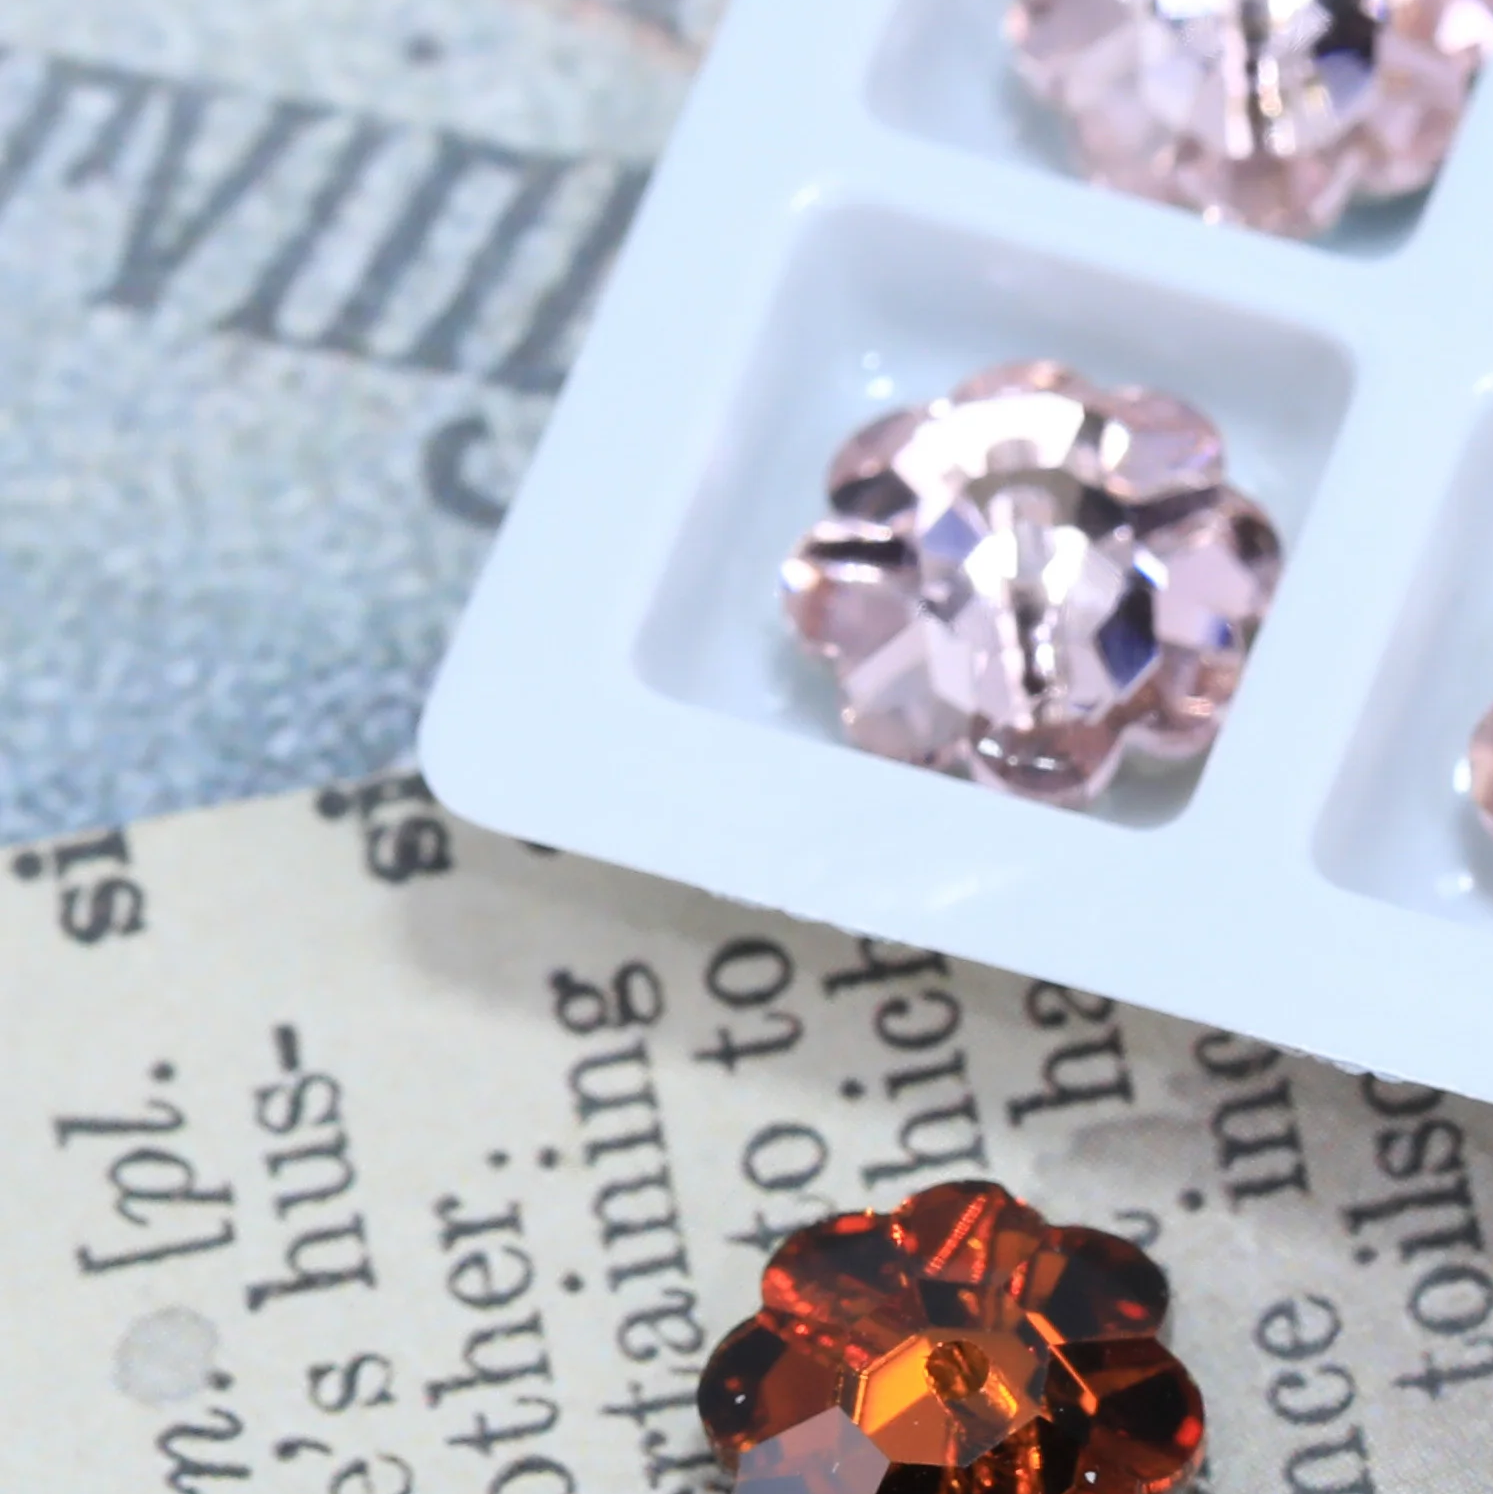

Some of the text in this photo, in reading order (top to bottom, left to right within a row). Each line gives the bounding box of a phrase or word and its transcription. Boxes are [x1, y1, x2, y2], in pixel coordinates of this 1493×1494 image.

[695, 931, 802, 1073] to
[53, 1061, 236, 1275] [pl.
[217, 1023, 377, 1312] hus-
